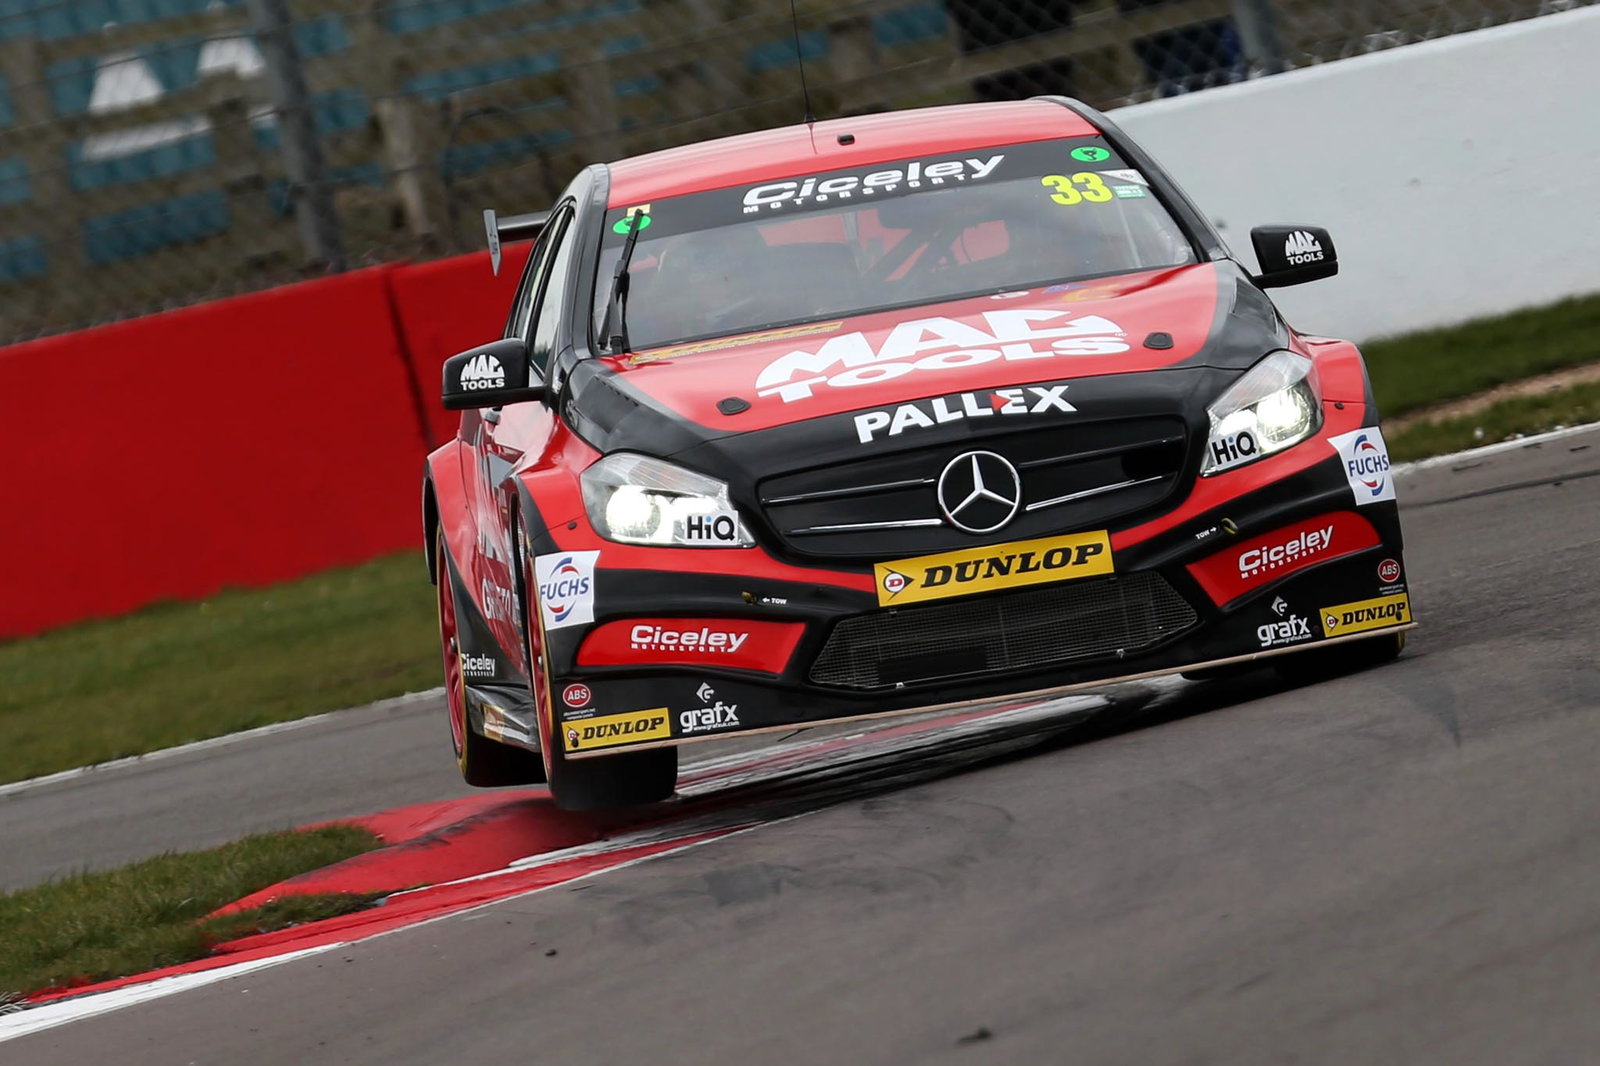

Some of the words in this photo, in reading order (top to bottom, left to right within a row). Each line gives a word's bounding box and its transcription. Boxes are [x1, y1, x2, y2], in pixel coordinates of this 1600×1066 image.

[743, 154, 1005, 206] Ciceley
[1041, 172, 1113, 206] 33
[743, 174, 967, 214] MOTORSPORT
[1285, 230, 1322, 257] MAC
[1287, 251, 1324, 265] TOOLS
[754, 309, 1124, 389] MAC
[460, 354, 505, 381] MAC
[756, 336, 1130, 404] TOOLS
[460, 378, 505, 391] TOOLS
[853, 385, 1078, 444] PALLEX
[1211, 431, 1256, 465] HiQ
[1347, 453, 1389, 477] FUCHS
[687, 515, 735, 541] HiQ
[1195, 529, 1211, 540] TOW
[1238, 525, 1334, 572] Ciceley
[1240, 545, 1322, 579] MOTORSPORT
[920, 542, 1104, 589] DUNLOP
[1381, 563, 1398, 576] ABS
[540, 577, 590, 601] FUCHS
[770, 597, 788, 605] TOW
[1341, 602, 1406, 626] DUNLOP
[631, 625, 749, 653] Ciceley
[1257, 614, 1311, 648] grafx
[631, 643, 726, 653] MOTORSPORT
[567, 688, 588, 702] ABS
[582, 716, 665, 740] DUNLOP
[680, 701, 739, 733] grafx
